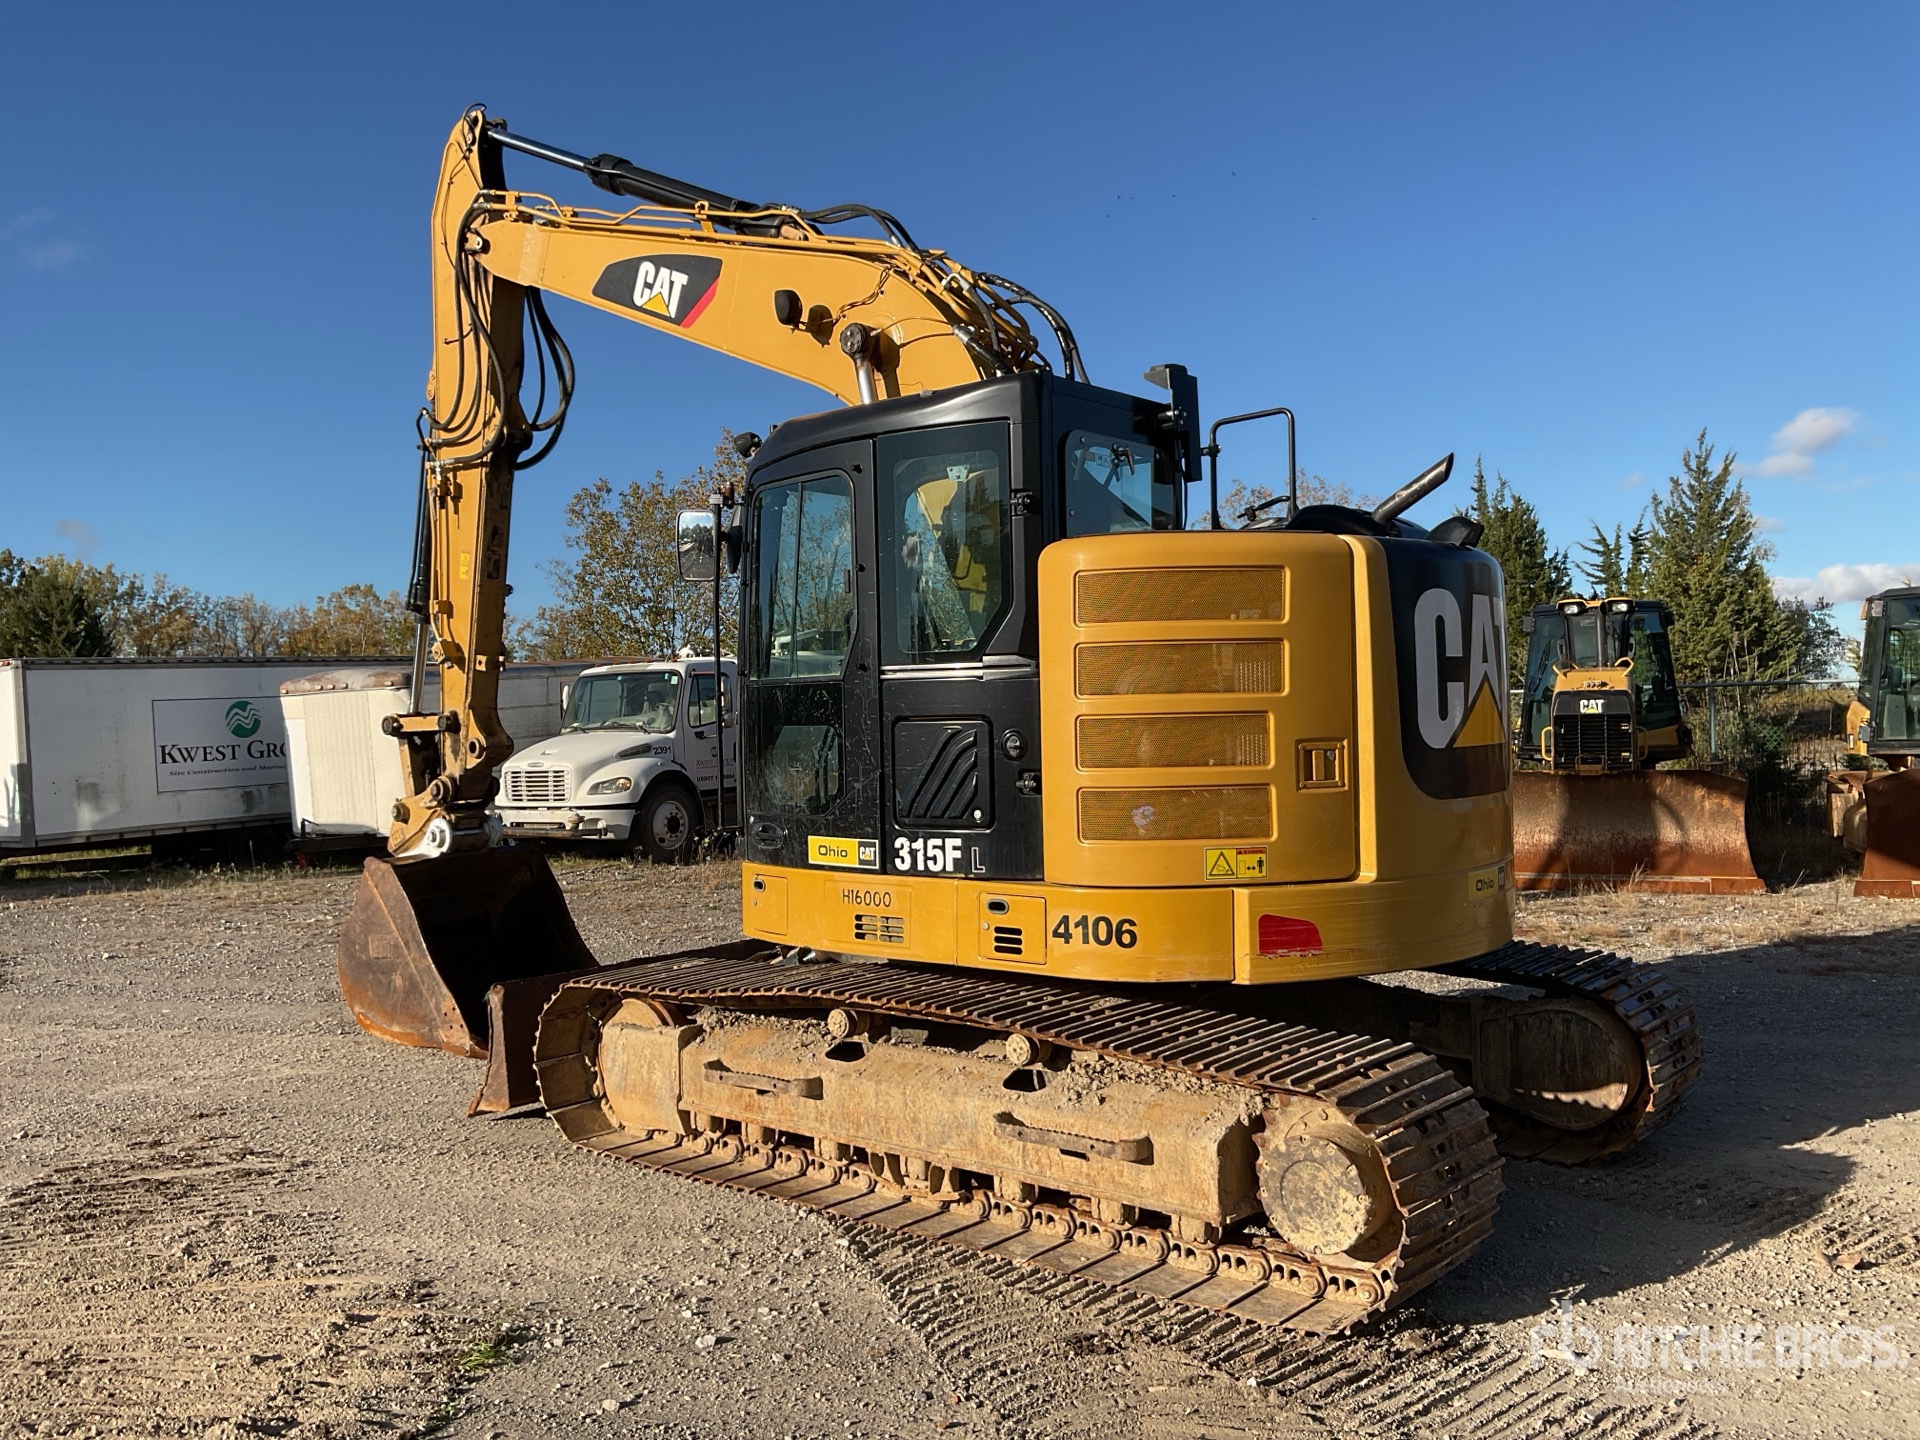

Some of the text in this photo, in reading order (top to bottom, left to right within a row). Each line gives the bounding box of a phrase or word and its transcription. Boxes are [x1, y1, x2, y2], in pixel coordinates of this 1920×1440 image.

[633, 261, 689, 318] CAT
[1580, 699, 1604, 713] CAT
[158, 743, 241, 765] KWEST
[653, 746, 672, 756] 2391
[187, 767, 240, 775] Construction
[818, 844, 876, 860] Ohio CAT
[894, 836, 986, 873] 315F L
[1475, 877, 1494, 891] Ohio
[842, 888, 892, 908] H16000
[1051, 914, 1138, 949] 4106
